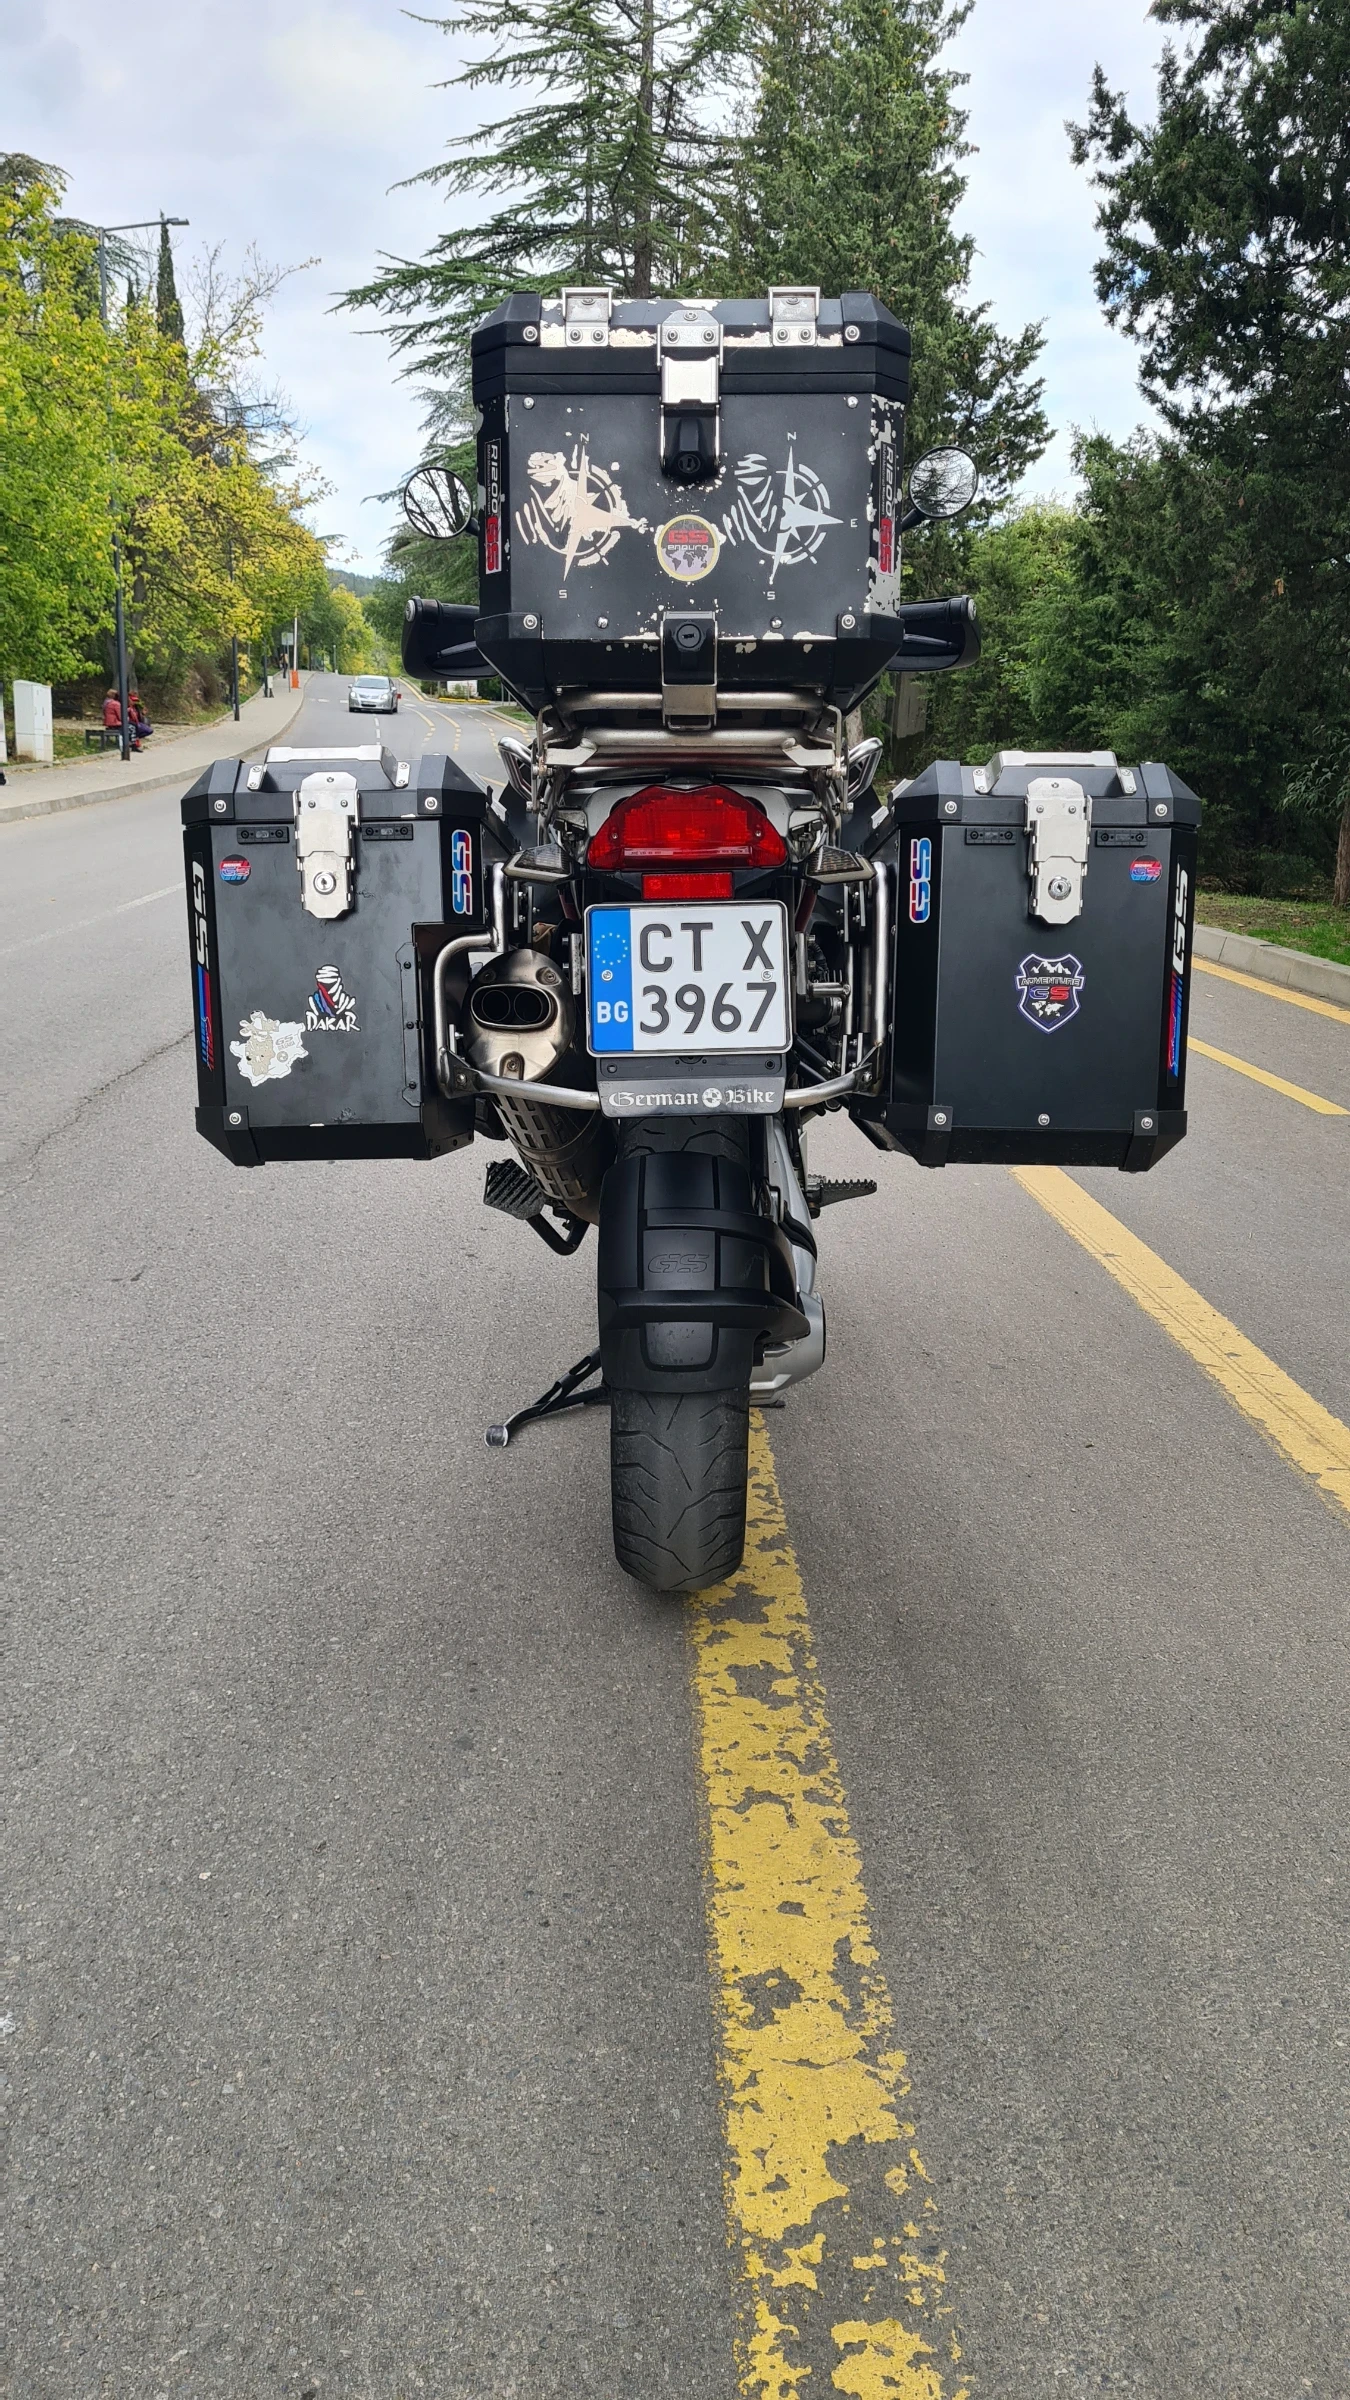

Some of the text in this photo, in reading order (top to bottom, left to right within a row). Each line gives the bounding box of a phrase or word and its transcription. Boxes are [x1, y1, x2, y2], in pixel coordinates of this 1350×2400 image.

[580, 433, 590, 442] N
[787, 432, 797, 441] N
[850, 518, 858, 528] E
[486, 515, 499, 571] GS
[668, 530, 709, 544] GS
[880, 518, 893, 573] GS
[558, 590, 568, 599] S
[767, 591, 776, 600] S
[452, 829, 472, 915] GS
[909, 837, 932, 923] GS
[192, 861, 209, 970] GS
[1172, 862, 1188, 975] GS
[1021, 977, 1080, 986] ADVENTURE
[1029, 986, 1070, 1000] GS
[596, 1001, 628, 1023] BG
[639, 982, 777, 1034] 3967
[608, 1088, 775, 1107] German Bike
[648, 1254, 710, 1273] GS
